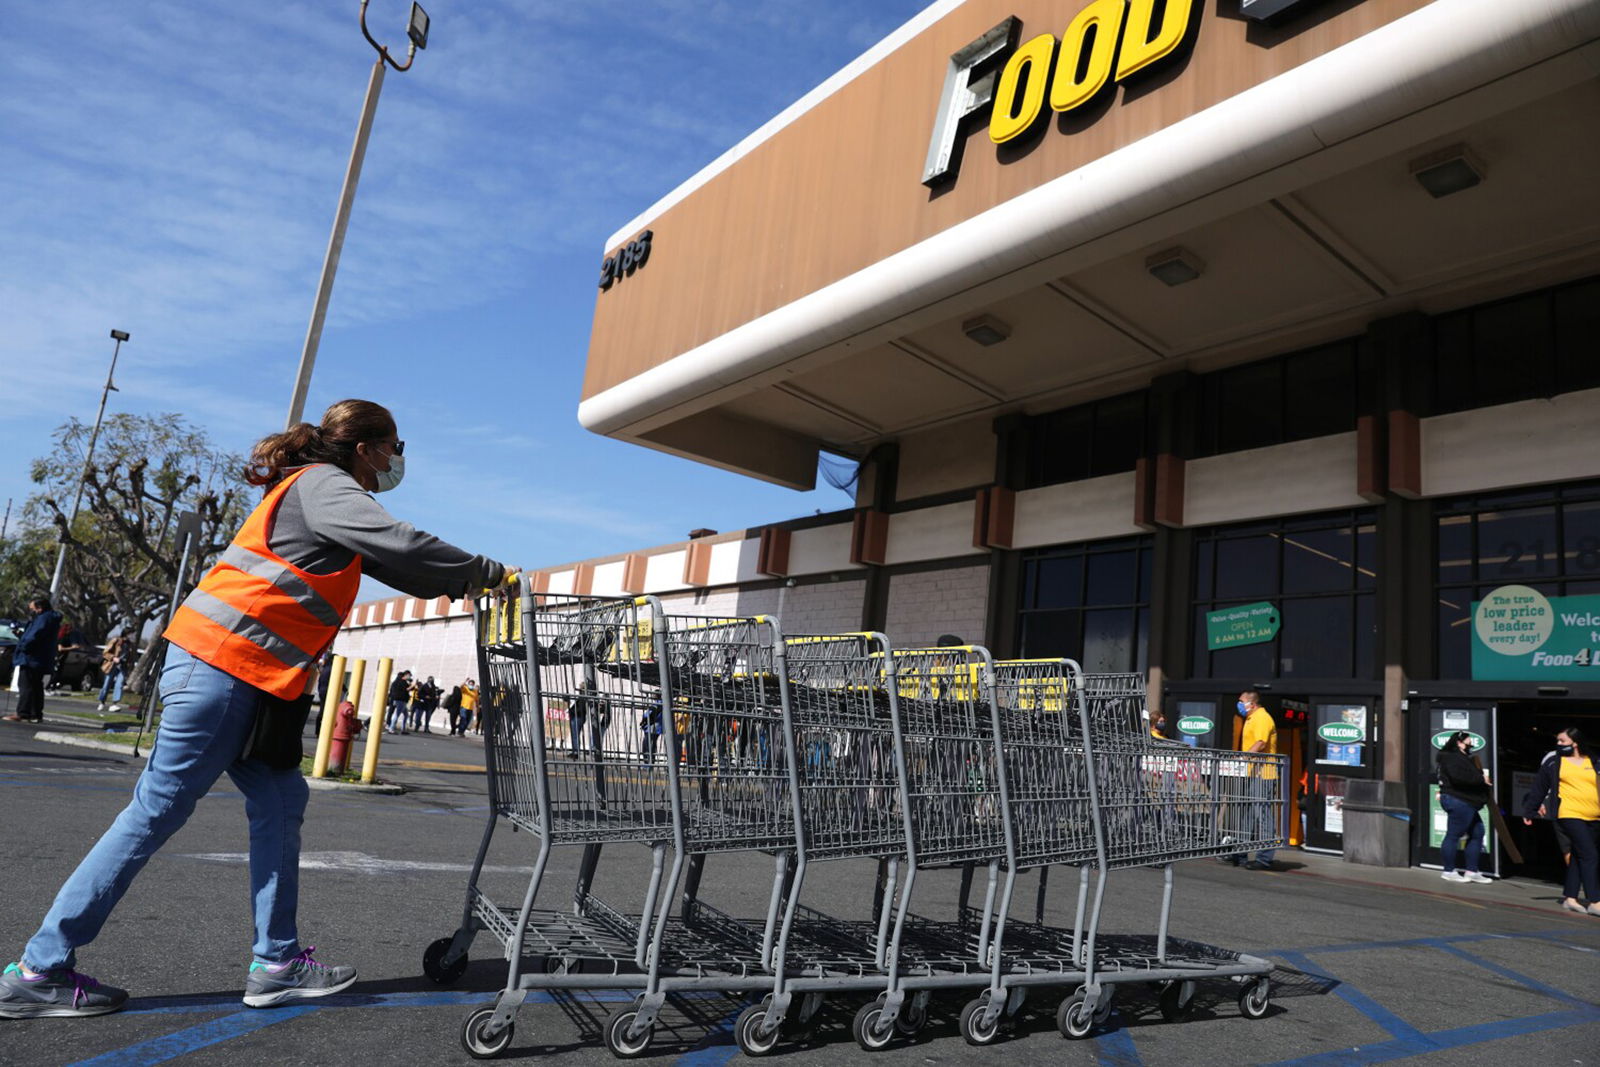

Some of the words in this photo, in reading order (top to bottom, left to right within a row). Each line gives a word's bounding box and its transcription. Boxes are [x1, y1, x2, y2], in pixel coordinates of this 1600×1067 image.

[599, 230, 652, 290] 2185
[1492, 597, 1511, 605] The
[1513, 595, 1535, 604] true
[1484, 607, 1506, 618] low
[1510, 605, 1545, 619] price
[1231, 621, 1254, 632] OPEN
[1493, 621, 1536, 632] leader
[1222, 633, 1236, 643] AM
[1258, 627, 1272, 636] AM
[1489, 635, 1516, 644] every
[1519, 633, 1541, 644] day!
[1181, 721, 1211, 730] WELCOME
[1322, 727, 1360, 738] WELCOME
